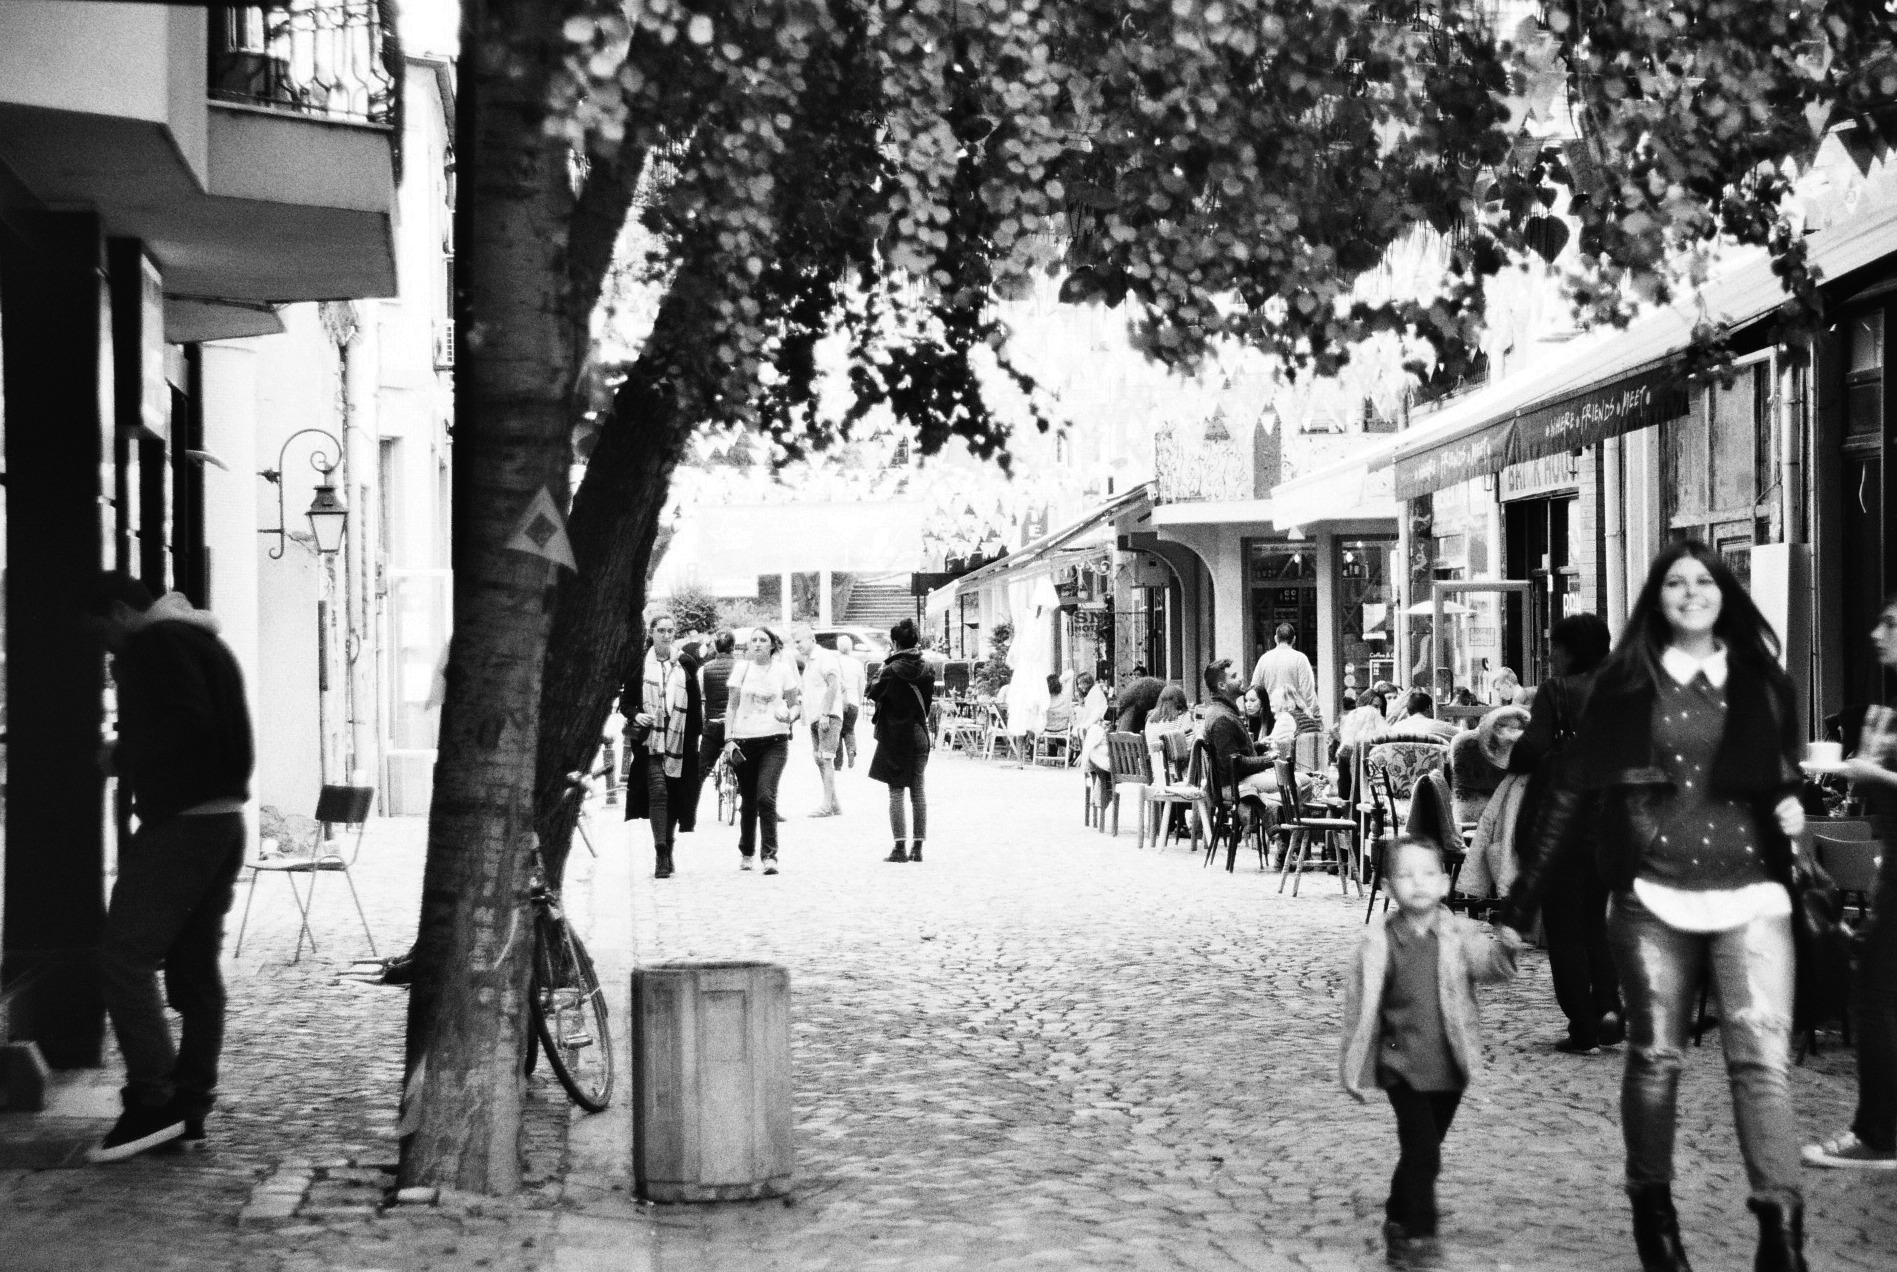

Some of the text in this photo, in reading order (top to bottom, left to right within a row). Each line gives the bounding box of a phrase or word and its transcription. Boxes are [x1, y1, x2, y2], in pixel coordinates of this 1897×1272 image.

[1550, 385, 1647, 437] WHERE FRIENDS MEET
[1508, 452, 1577, 491] BRIK HOU
